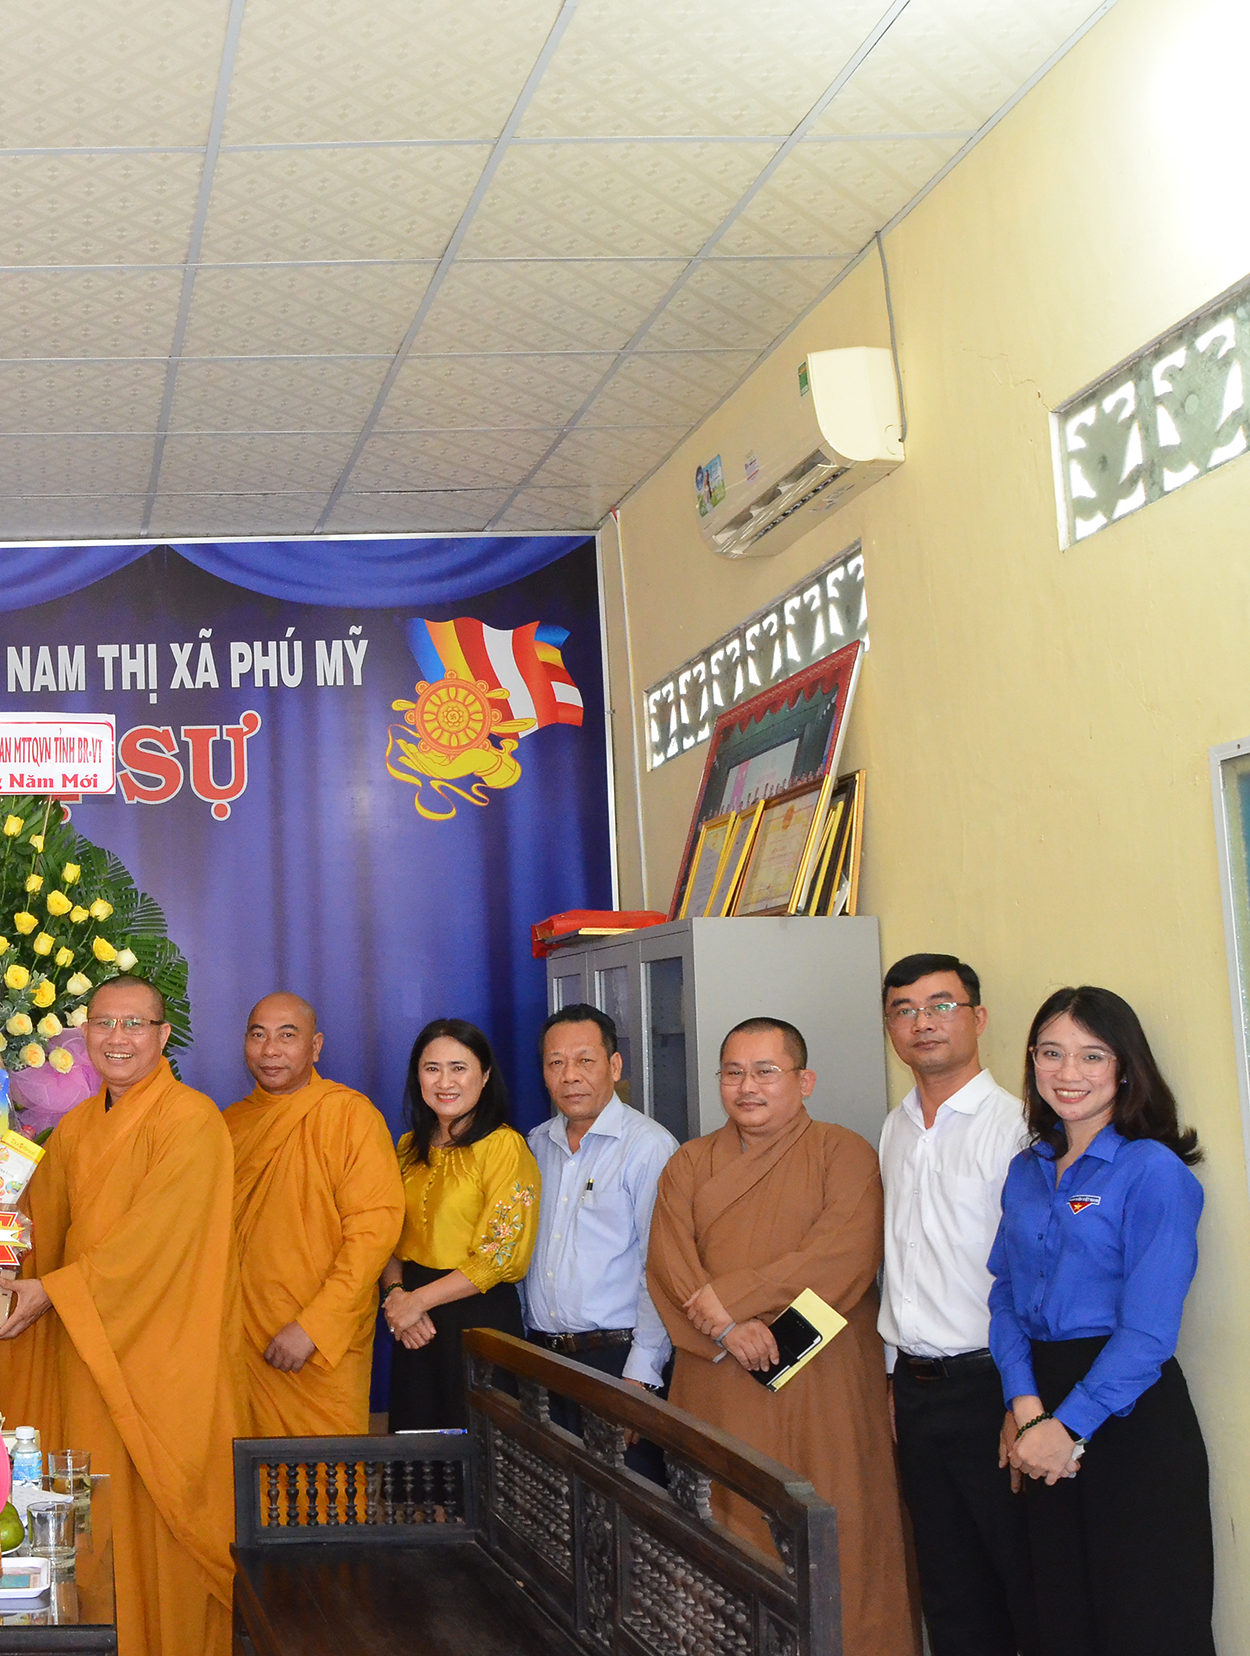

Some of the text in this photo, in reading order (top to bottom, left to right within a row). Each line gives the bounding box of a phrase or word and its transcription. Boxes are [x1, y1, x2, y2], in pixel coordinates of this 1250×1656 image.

[7, 645, 86, 692] NAM
[97, 643, 158, 704] THỊ
[169, 628, 219, 690] XÃ
[230, 627, 302, 688] PHÚ
[315, 625, 369, 686] MỸ
[14, 736, 51, 767] MTTQVN
[54, 727, 75, 763] TỈNH
[116, 709, 262, 821] SỰ
[8, 773, 54, 788] Năm
[61, 773, 98, 788] Mới
